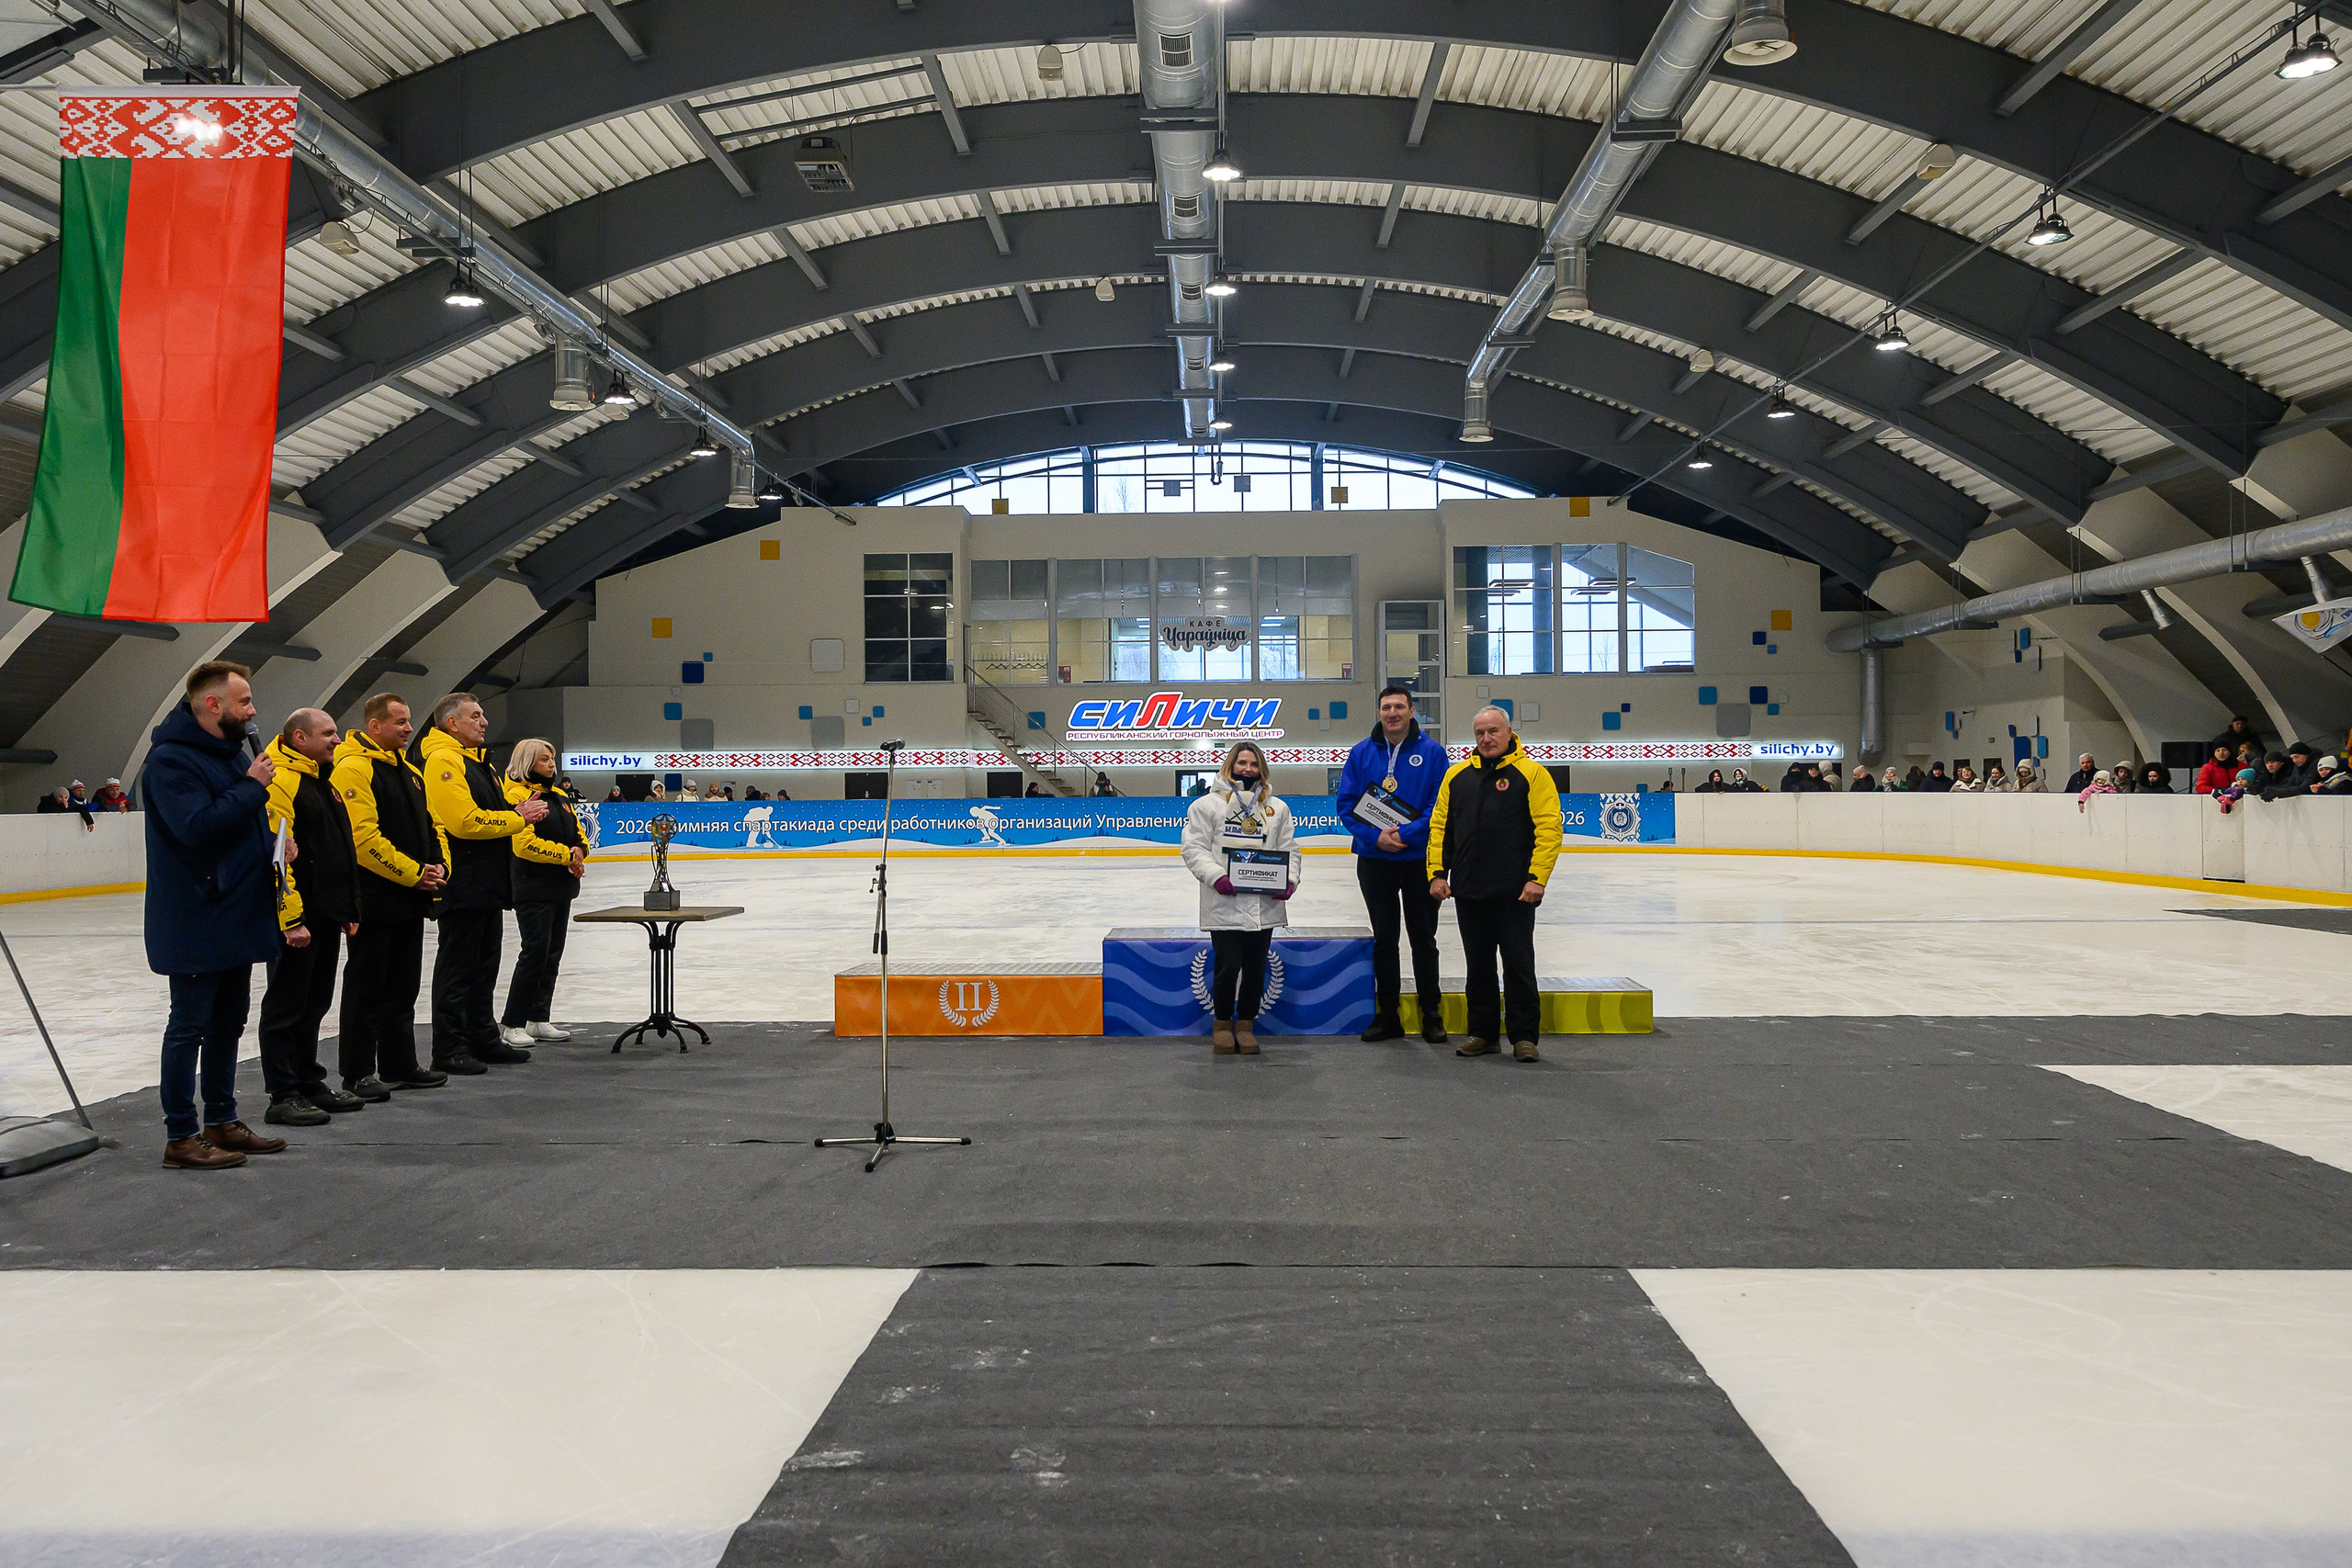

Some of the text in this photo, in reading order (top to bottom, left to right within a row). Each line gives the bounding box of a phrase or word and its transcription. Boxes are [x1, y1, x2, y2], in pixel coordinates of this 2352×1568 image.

[1189, 620, 1221, 628] КАФЕ
[1068, 730, 1283, 739] РЕСПУБЛИКАНСКИЙ ГОРНОЛЫЖНЫЙ ЦЕНТР
[1760, 743, 1835, 756] silichy.by
[570, 755, 641, 768] silichy.by
[474, 816, 507, 827] BELARUS
[616, 820, 652, 834] 2026
[733, 818, 835, 834] спартакиада
[839, 817, 887, 834] среди
[891, 815, 985, 833] работников
[989, 814, 1091, 833] организаций
[1094, 814, 1190, 832] Управления
[526, 843, 563, 859] BELARUS
[369, 848, 404, 877] BELARUS
[1238, 869, 1279, 877] СЕРТИФИКАТ
